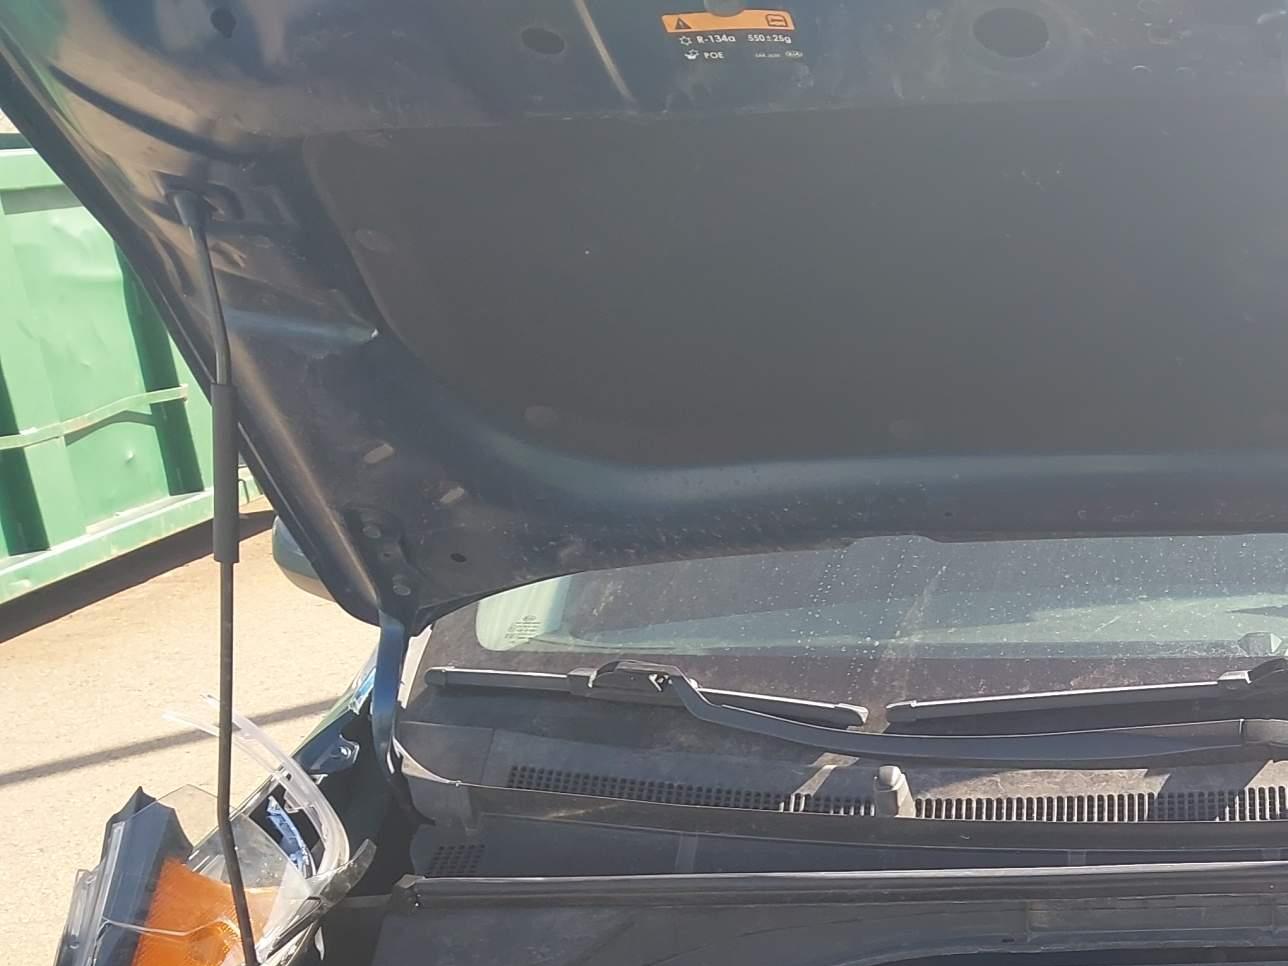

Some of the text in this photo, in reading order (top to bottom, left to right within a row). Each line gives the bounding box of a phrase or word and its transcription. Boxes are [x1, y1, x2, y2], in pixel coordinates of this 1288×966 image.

[696, 34, 792, 44] R-134a 550±25g
[703, 51, 725, 60] POE
